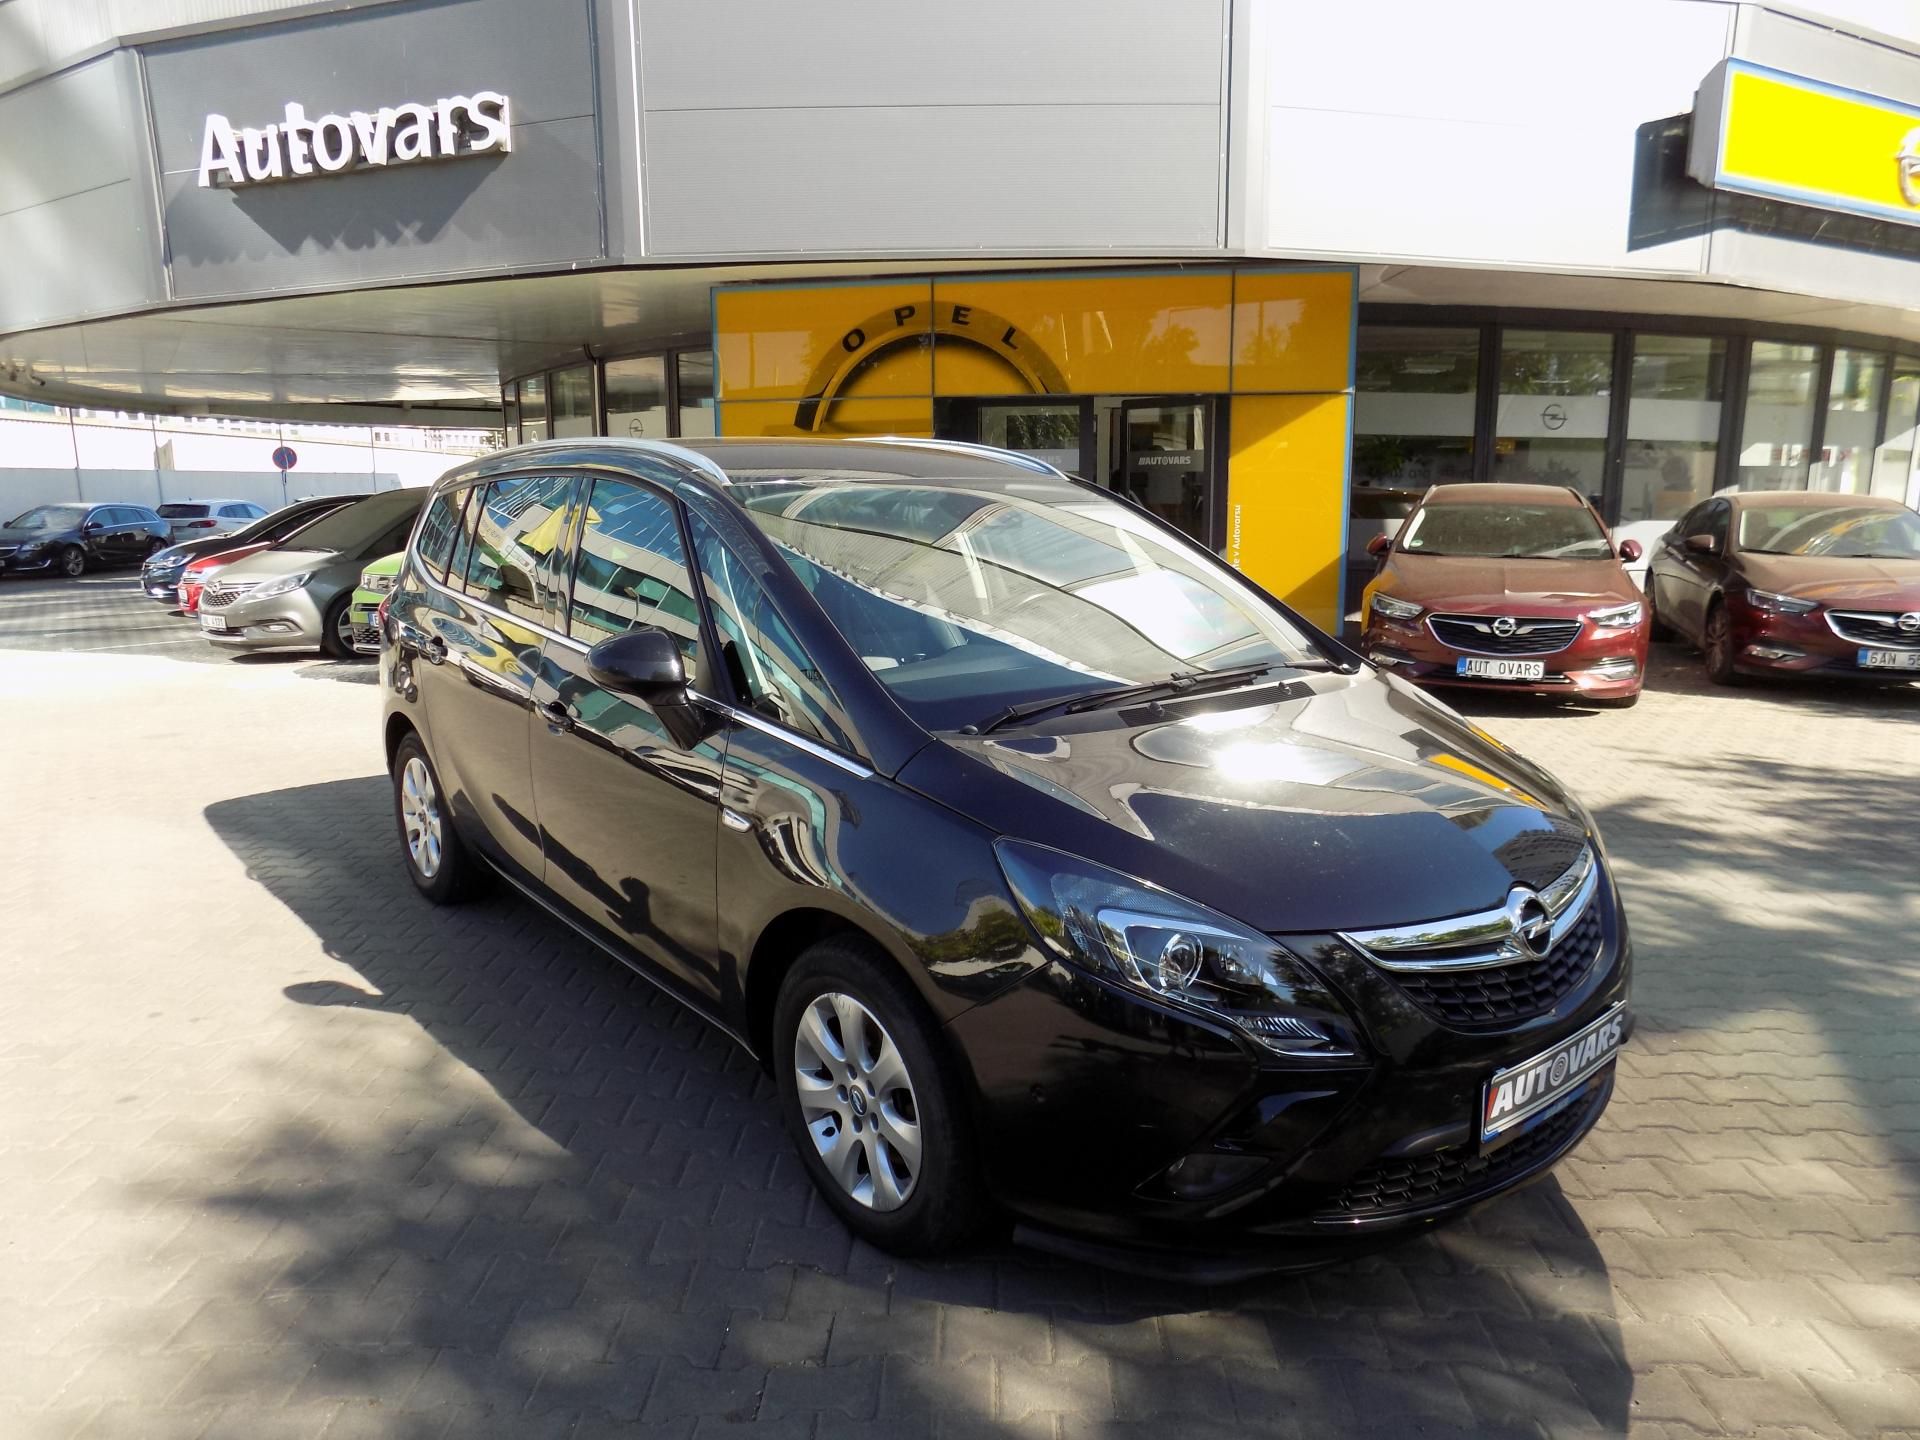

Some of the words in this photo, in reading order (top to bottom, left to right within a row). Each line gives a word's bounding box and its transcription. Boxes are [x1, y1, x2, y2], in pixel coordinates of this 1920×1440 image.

[198, 91, 511, 187] Autovars
[842, 305, 1021, 352] OPEL
[1144, 456, 1191, 465] AUTOVARS
[1232, 505, 1241, 549] Autovarsu
[1467, 661, 1490, 673] AUT
[1499, 662, 1541, 677] OVARS
[1490, 1014, 1624, 1119] AUTOVARS
